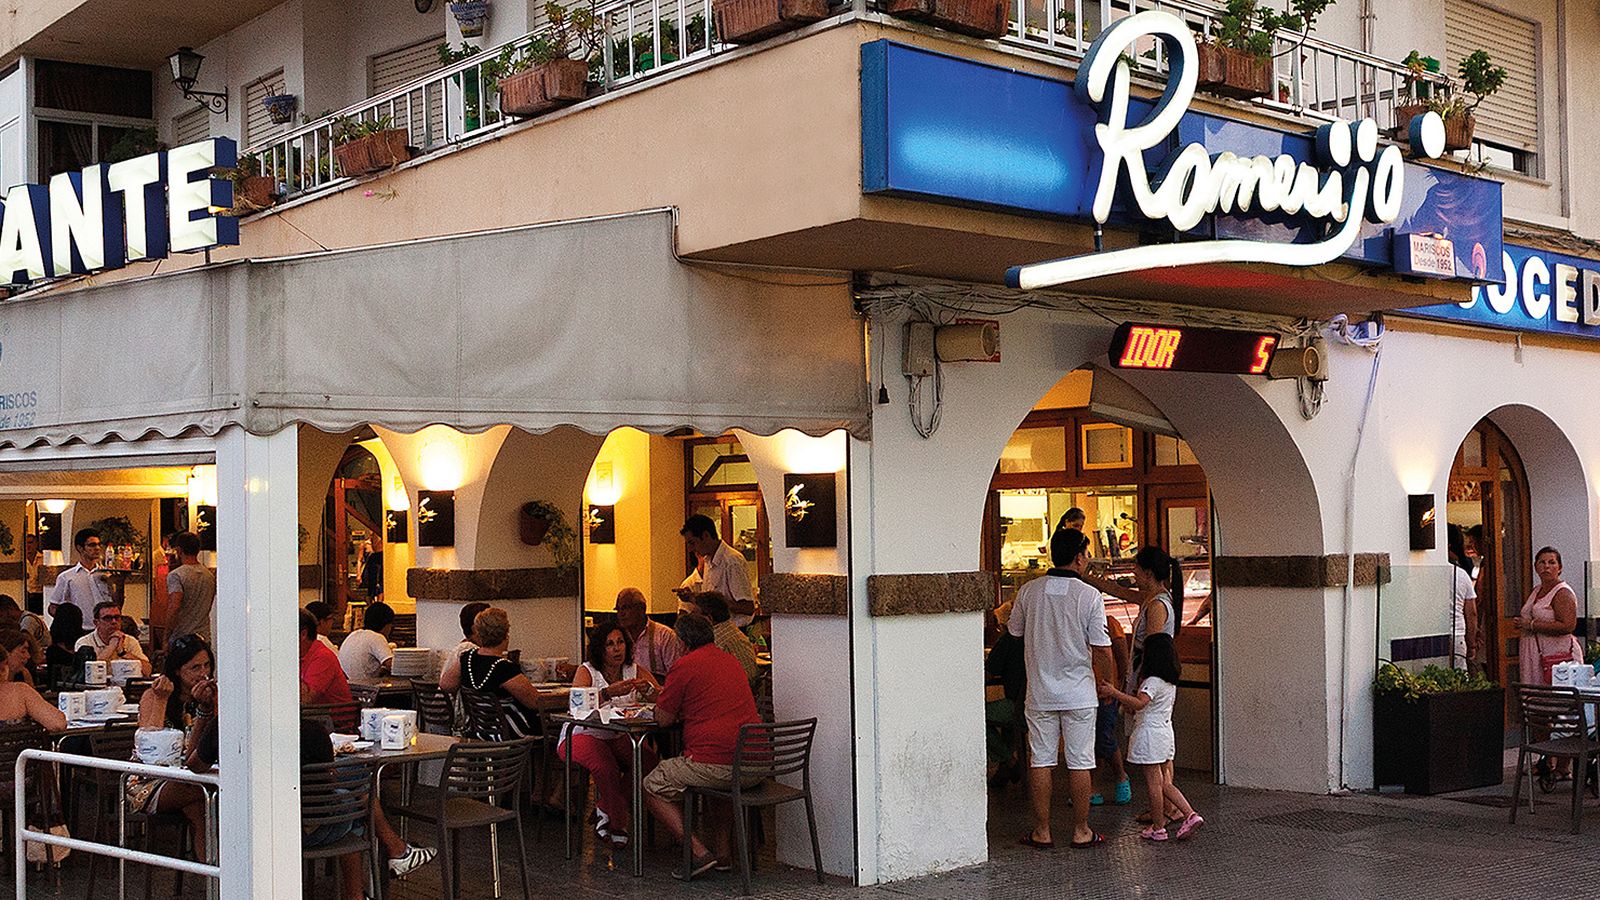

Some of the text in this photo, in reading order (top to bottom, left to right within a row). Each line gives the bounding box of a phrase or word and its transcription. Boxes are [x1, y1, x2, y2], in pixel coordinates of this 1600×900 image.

[1018, 10, 1411, 286] Romerijo
[0, 137, 220, 286] ANTE
[1412, 240, 1452, 258] MARISCOS
[1413, 254, 1452, 272] Desde 1952
[1459, 250, 1600, 326] OCED
[1119, 327, 1276, 374] IDOR 5
